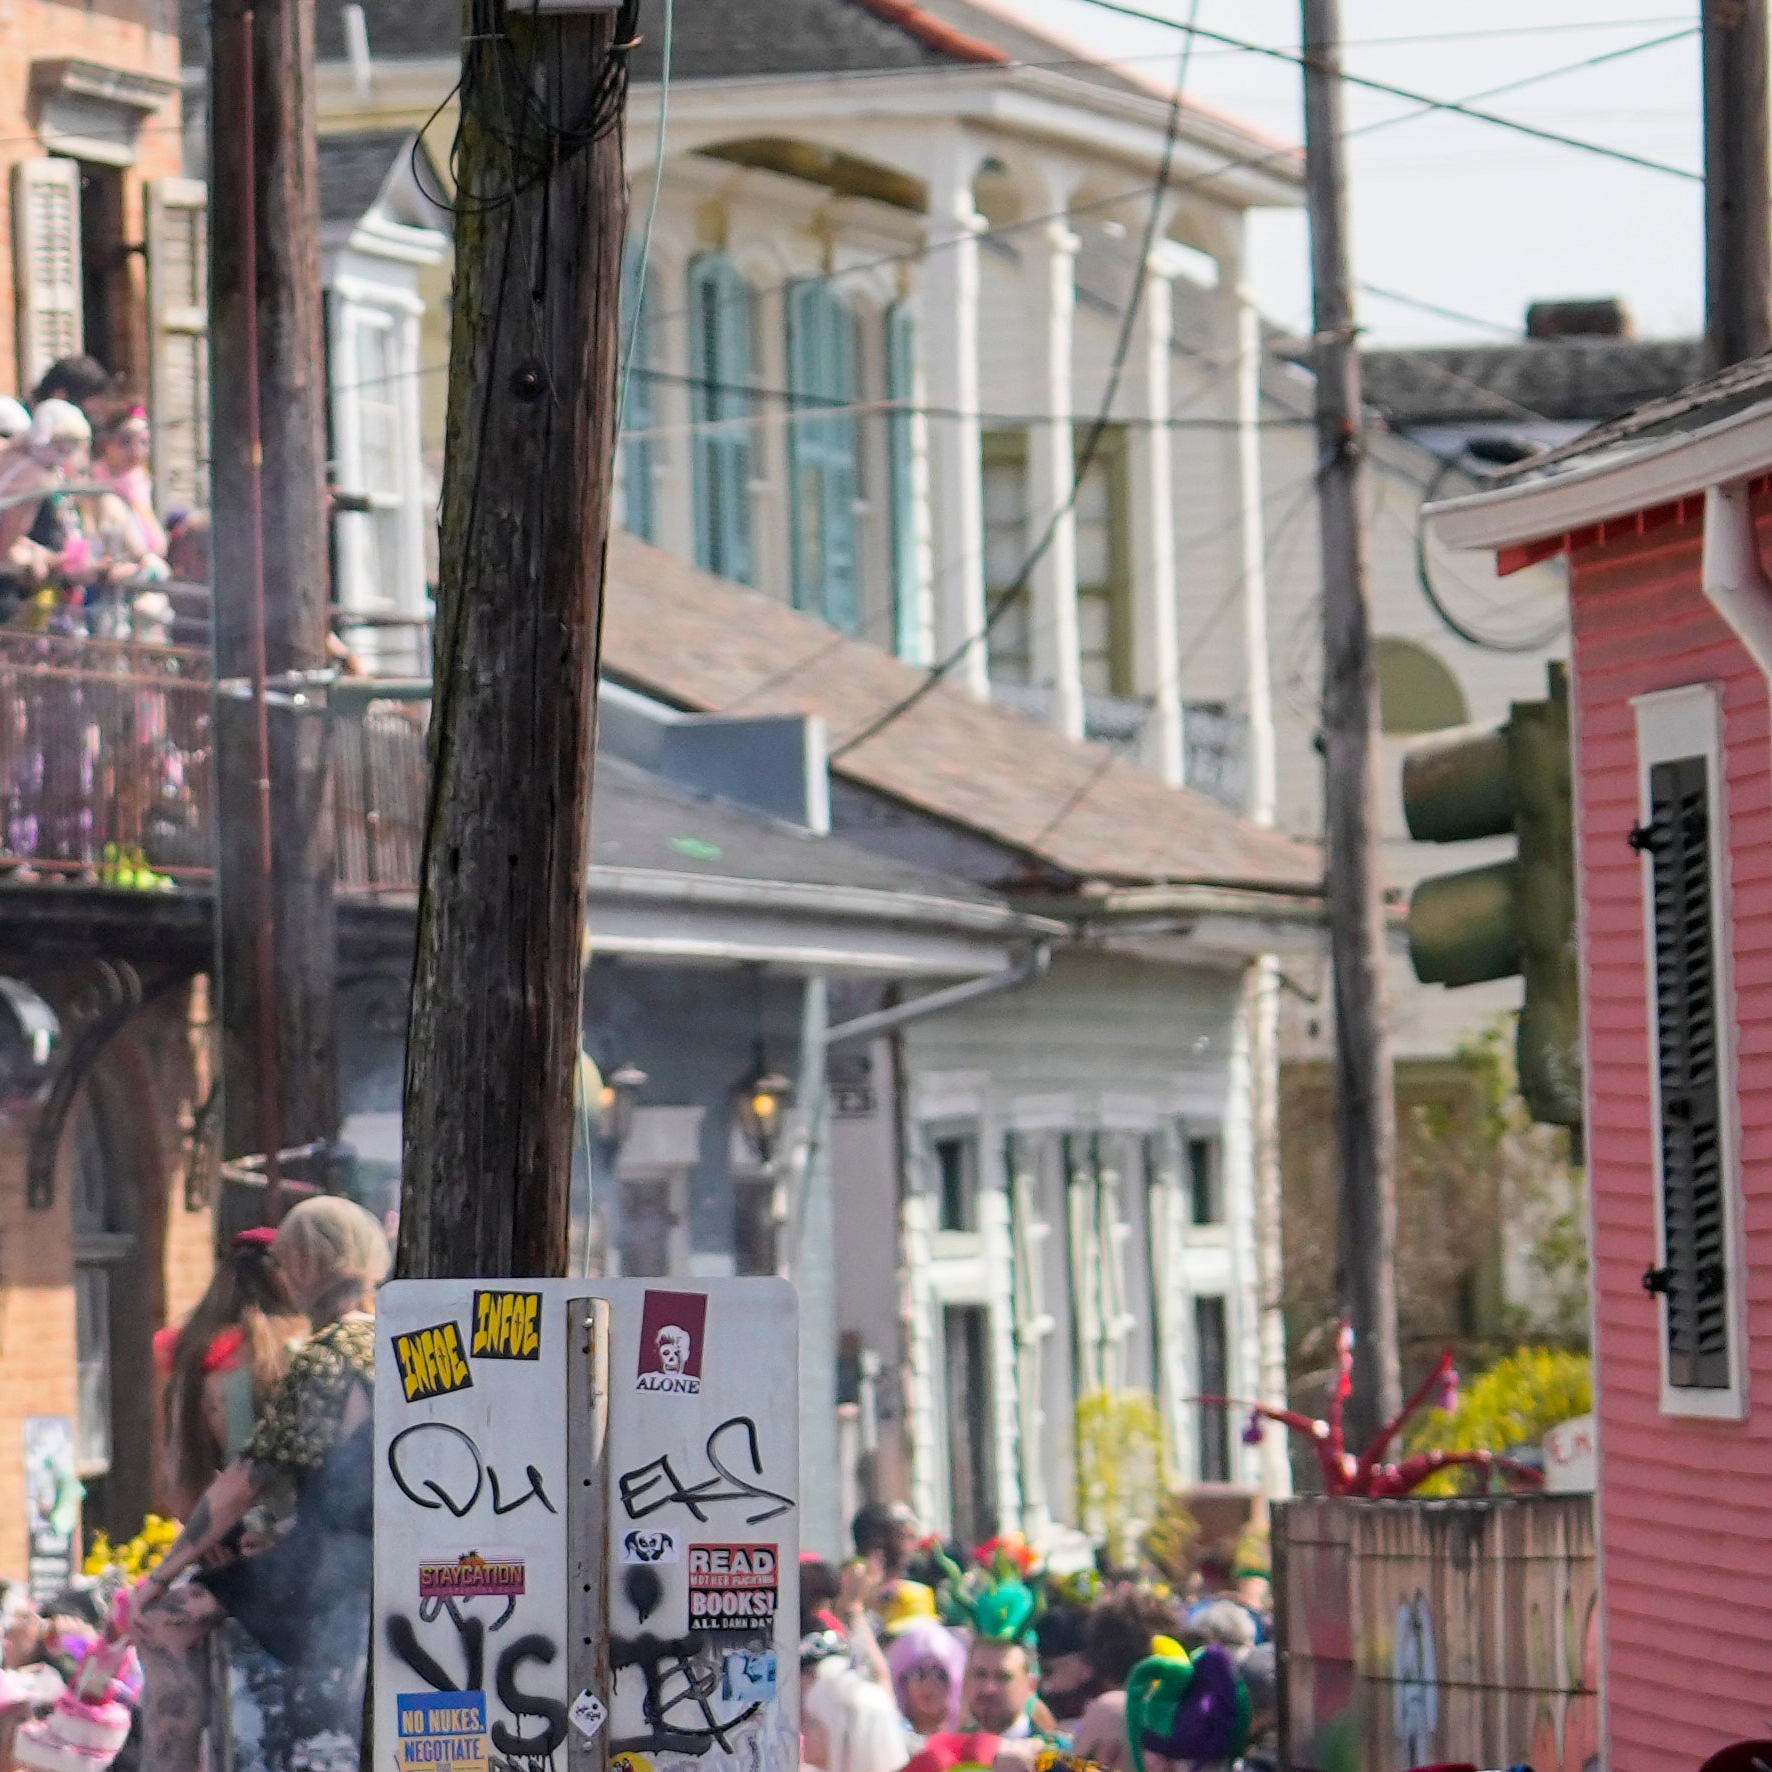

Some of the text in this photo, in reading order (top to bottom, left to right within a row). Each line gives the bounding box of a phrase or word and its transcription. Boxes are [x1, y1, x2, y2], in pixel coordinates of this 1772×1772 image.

[636, 1376, 700, 1395] ALONE
[690, 1549, 774, 1575] READ
[420, 1564, 525, 1588] STAYCATION
[691, 1589, 774, 1616] BOOKS!
[691, 1618, 721, 1630] ALL
[402, 1708, 484, 1733] NO NUKES.
[404, 1738, 484, 1763] NEGOTIATE.
